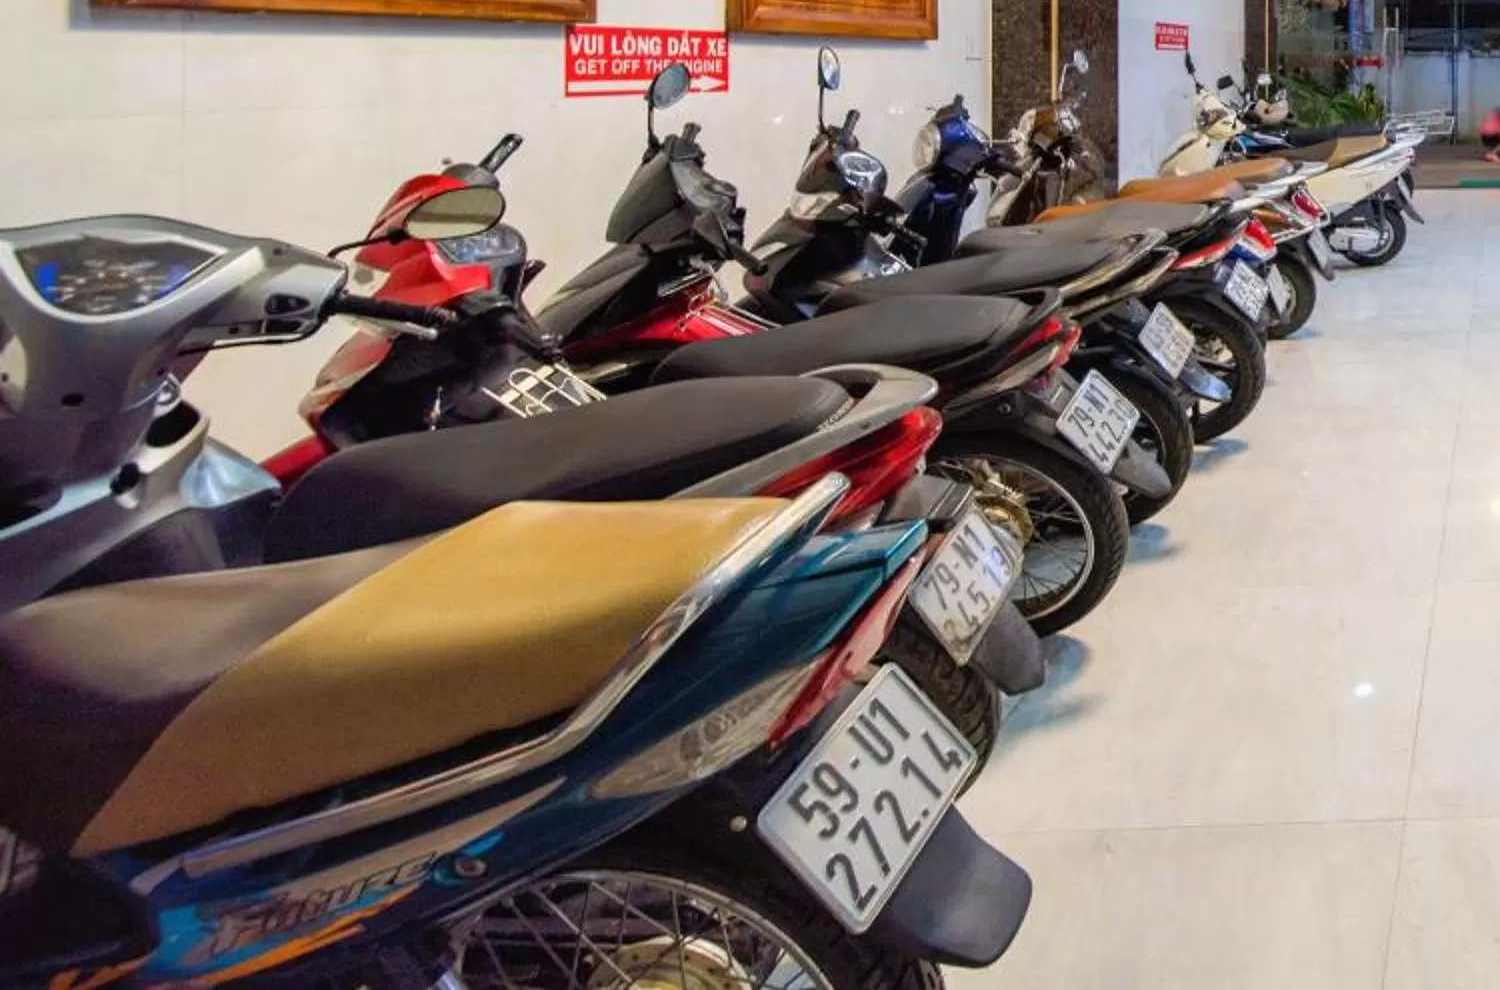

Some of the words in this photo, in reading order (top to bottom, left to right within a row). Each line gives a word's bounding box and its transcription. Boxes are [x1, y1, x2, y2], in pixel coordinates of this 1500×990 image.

[569, 33, 604, 56] VUI
[611, 29, 662, 57] LÒNG
[706, 37, 727, 57] XE
[575, 58, 608, 75] GET
[611, 58, 640, 75] OFF
[676, 59, 722, 73] NGINE
[787, 697, 910, 839] 59-U1
[824, 731, 963, 912] 272.14
